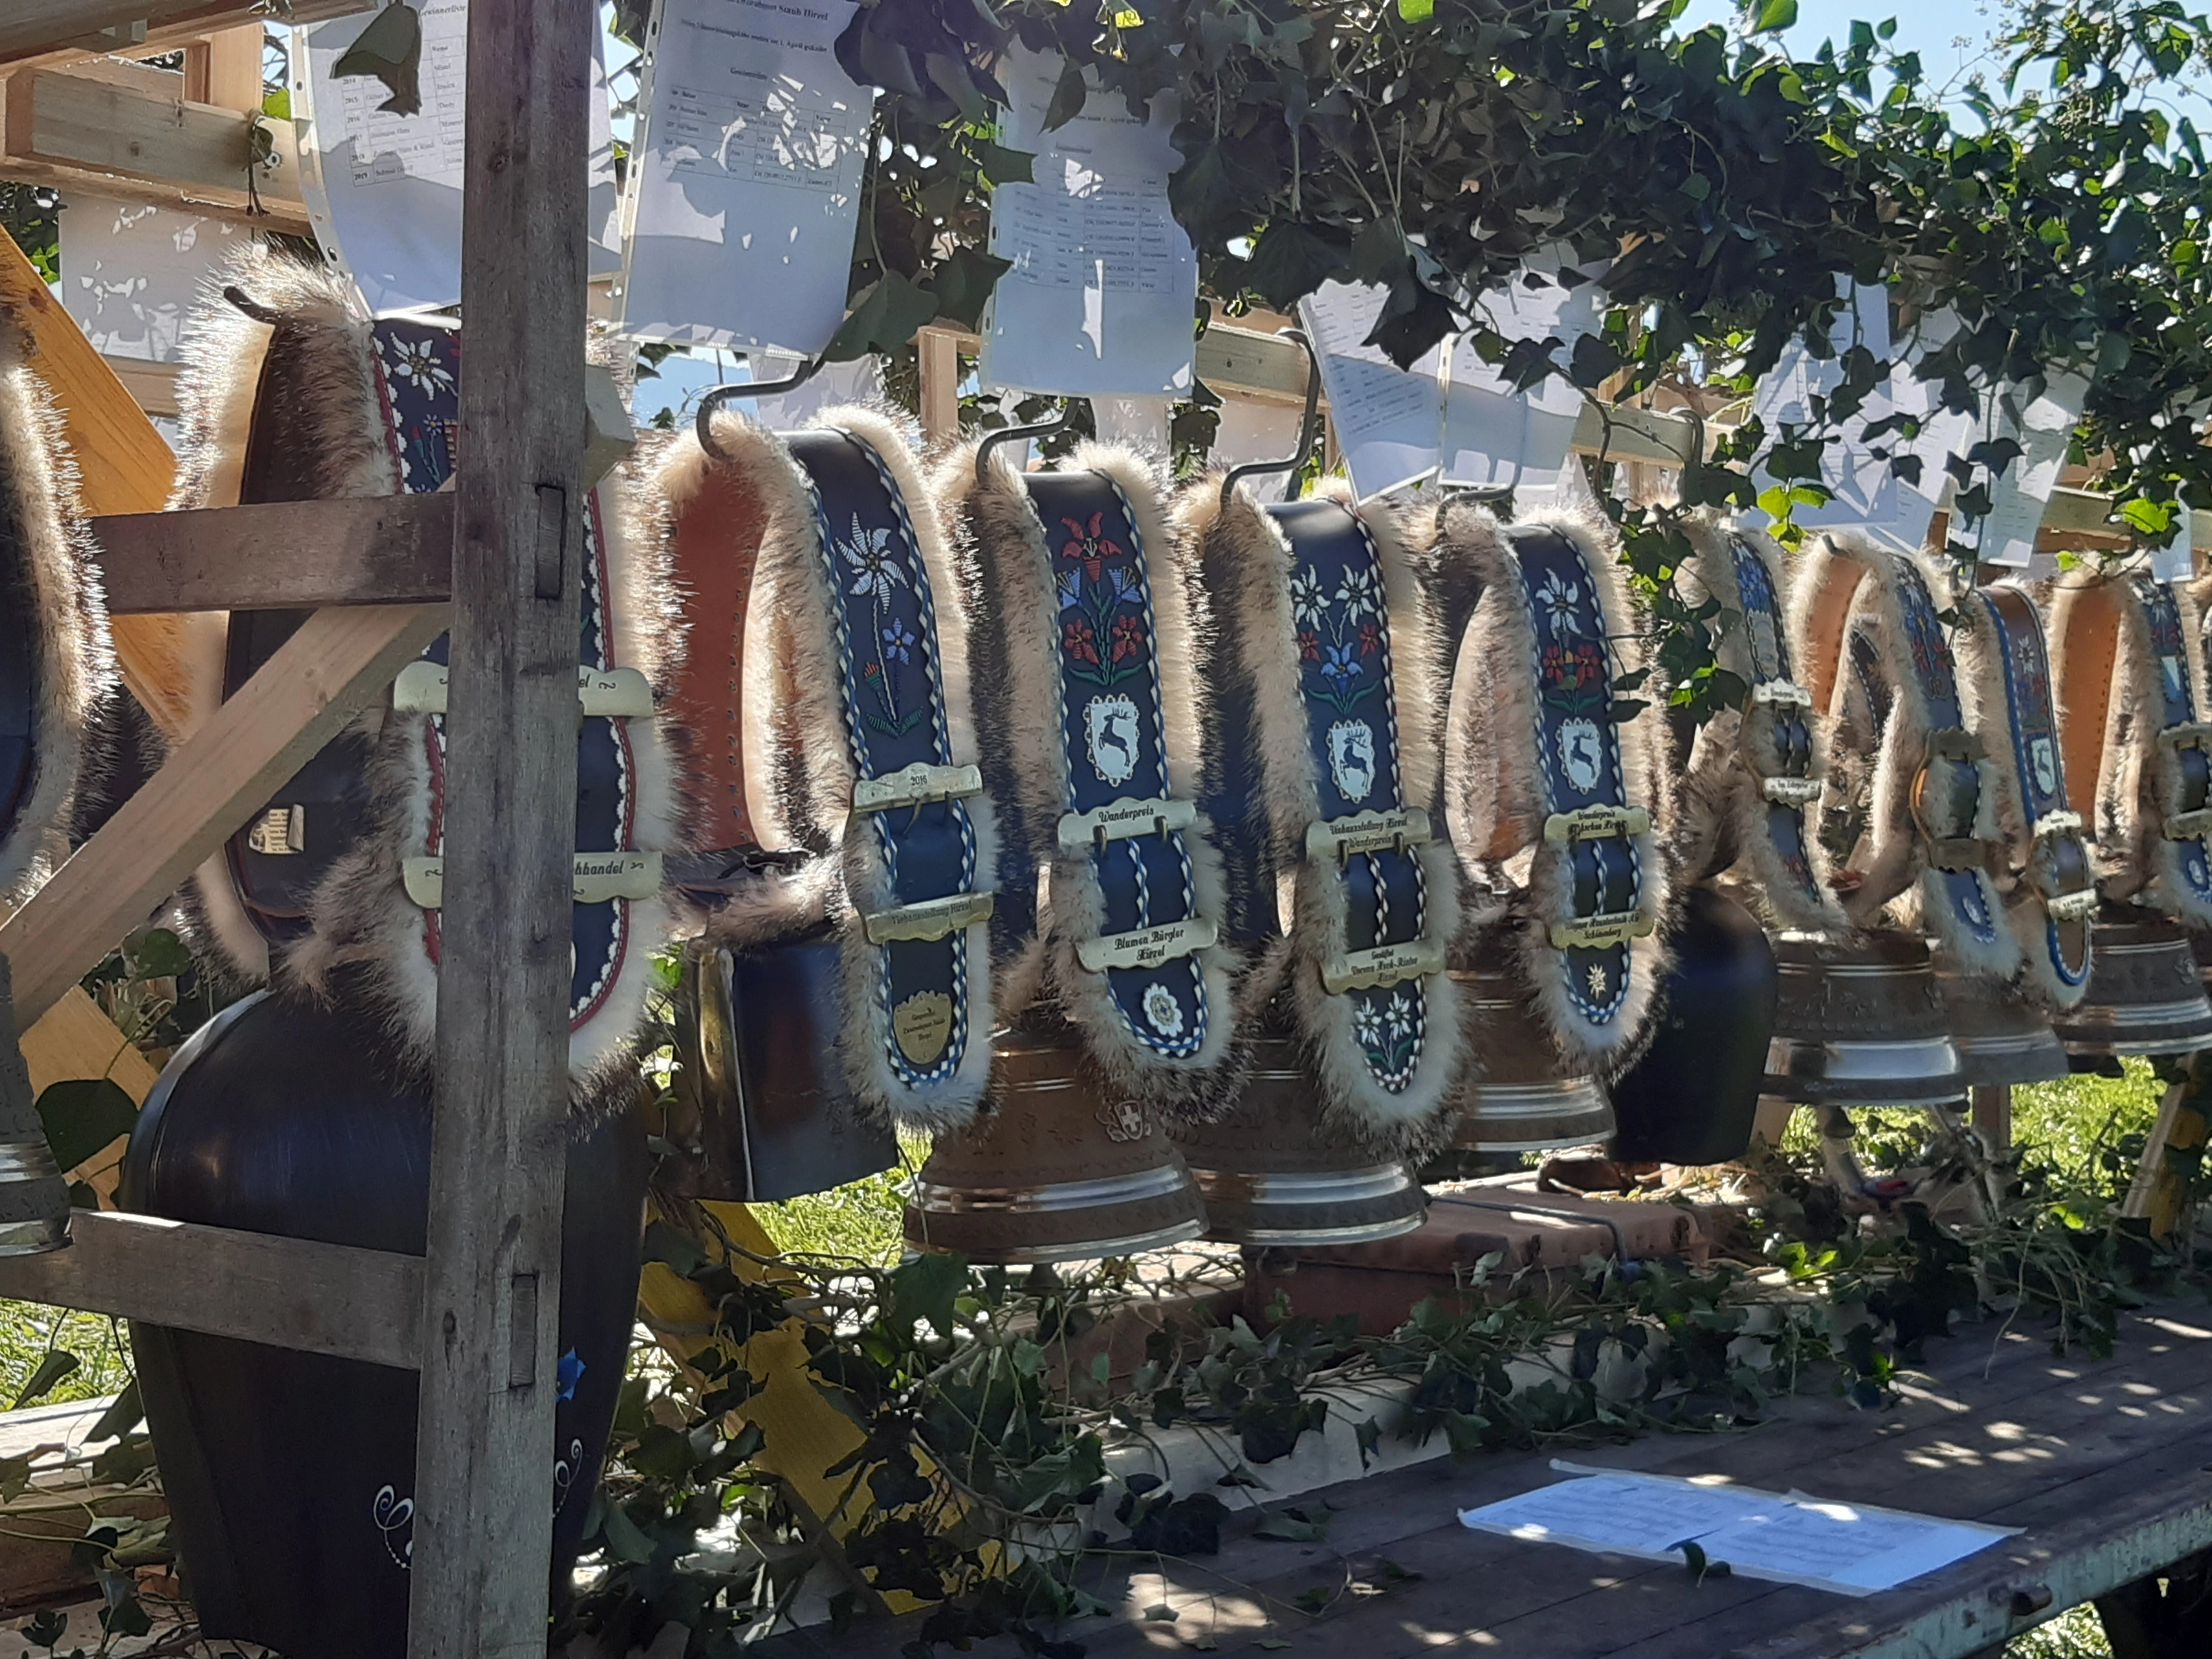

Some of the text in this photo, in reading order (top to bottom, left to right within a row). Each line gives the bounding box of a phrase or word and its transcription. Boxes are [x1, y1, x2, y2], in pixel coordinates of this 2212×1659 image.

[1098, 805, 1154, 823] Wanderpreis
[1115, 927, 1184, 950] Blumen Bürgler
[1136, 945, 1165, 961] Hirzel
